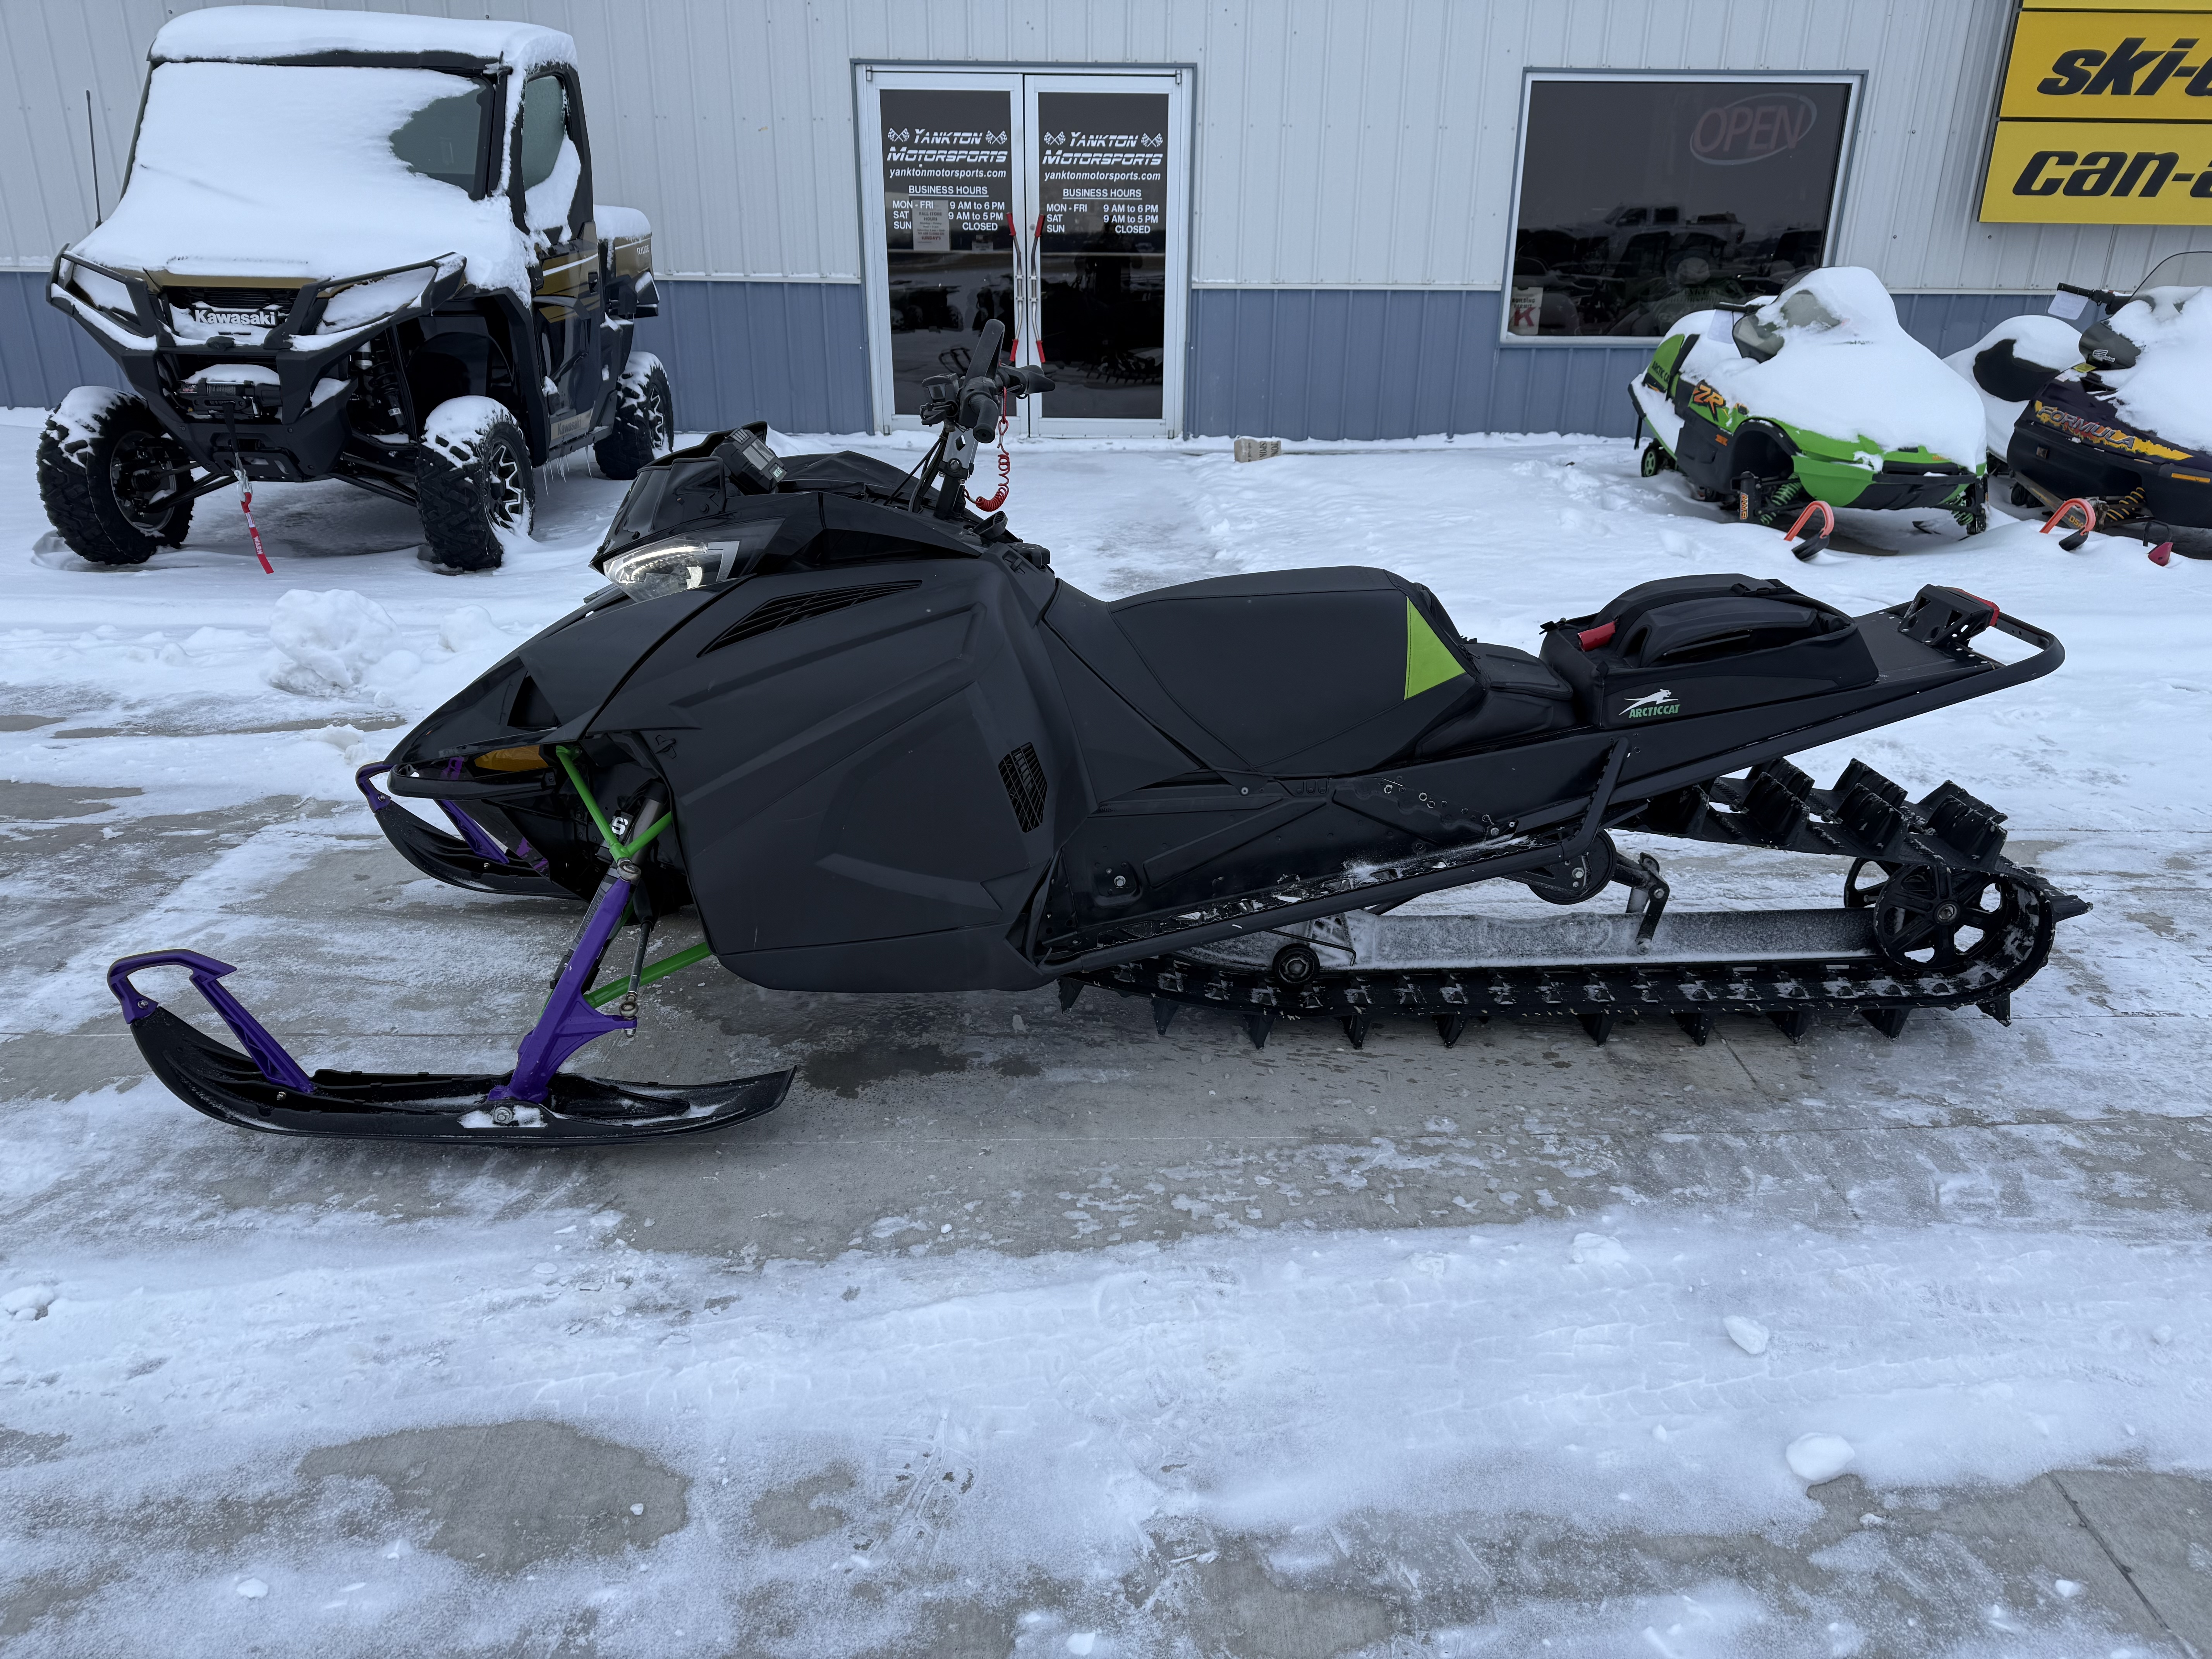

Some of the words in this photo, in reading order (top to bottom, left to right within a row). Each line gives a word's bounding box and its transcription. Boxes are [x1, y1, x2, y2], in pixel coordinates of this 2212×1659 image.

[914, 129, 982, 144] YANKTON
[1693, 105, 1806, 153] OPEN
[1070, 132, 1138, 147] YANKTON
[887, 146, 1008, 162] MOTORSPORTS
[1042, 150, 1163, 165] MOTORSPORTS
[890, 167, 1006, 179] yanktonmotorsports.com
[1044, 170, 1161, 182] yanktonmotorsports.com
[909, 185, 953, 194] BUSINESS
[956, 186, 988, 194] HOURS
[1063, 189, 1108, 197] BUSINESS
[1110, 189, 1141, 197] HOURS
[893, 200, 913, 208] MON
[920, 201, 933, 209] FRI
[950, 201, 955, 209] 9
[958, 201, 971, 210] AM
[974, 201, 982, 210] to
[984, 201, 989, 210] 6
[992, 202, 1005, 210] PM
[1046, 204, 1066, 212] MON
[1074, 204, 1087, 212] FRI
[1103, 204, 1109, 213] 9
[1111, 204, 1125, 213] AM
[1127, 204, 1135, 213] to
[1138, 204, 1143, 213] 6
[1145, 204, 1158, 213] PM
[893, 211, 909, 219] SAT
[948, 211, 954, 220] 9
[956, 212, 969, 220] AM
[983, 212, 988, 220] 5
[990, 212, 1003, 220] PM
[1047, 214, 1063, 222] SAT
[1103, 215, 1109, 223] 9
[1127, 215, 1135, 223] to
[1137, 215, 1143, 223] 5
[1145, 215, 1158, 223] PM
[894, 221, 912, 229] SUN
[962, 222, 998, 231] CLOSED
[1047, 225, 1065, 233] SUN
[1115, 225, 1151, 234] CLOSED
[195, 309, 275, 325] Kawasaki
[1652, 360, 1665, 378] ARCTIC
[1693, 384, 1725, 415] ZR
[558, 416, 582, 436] Kawasaki
[2037, 406, 2135, 449] FORMULA
[253, 536, 263, 555] WARN
